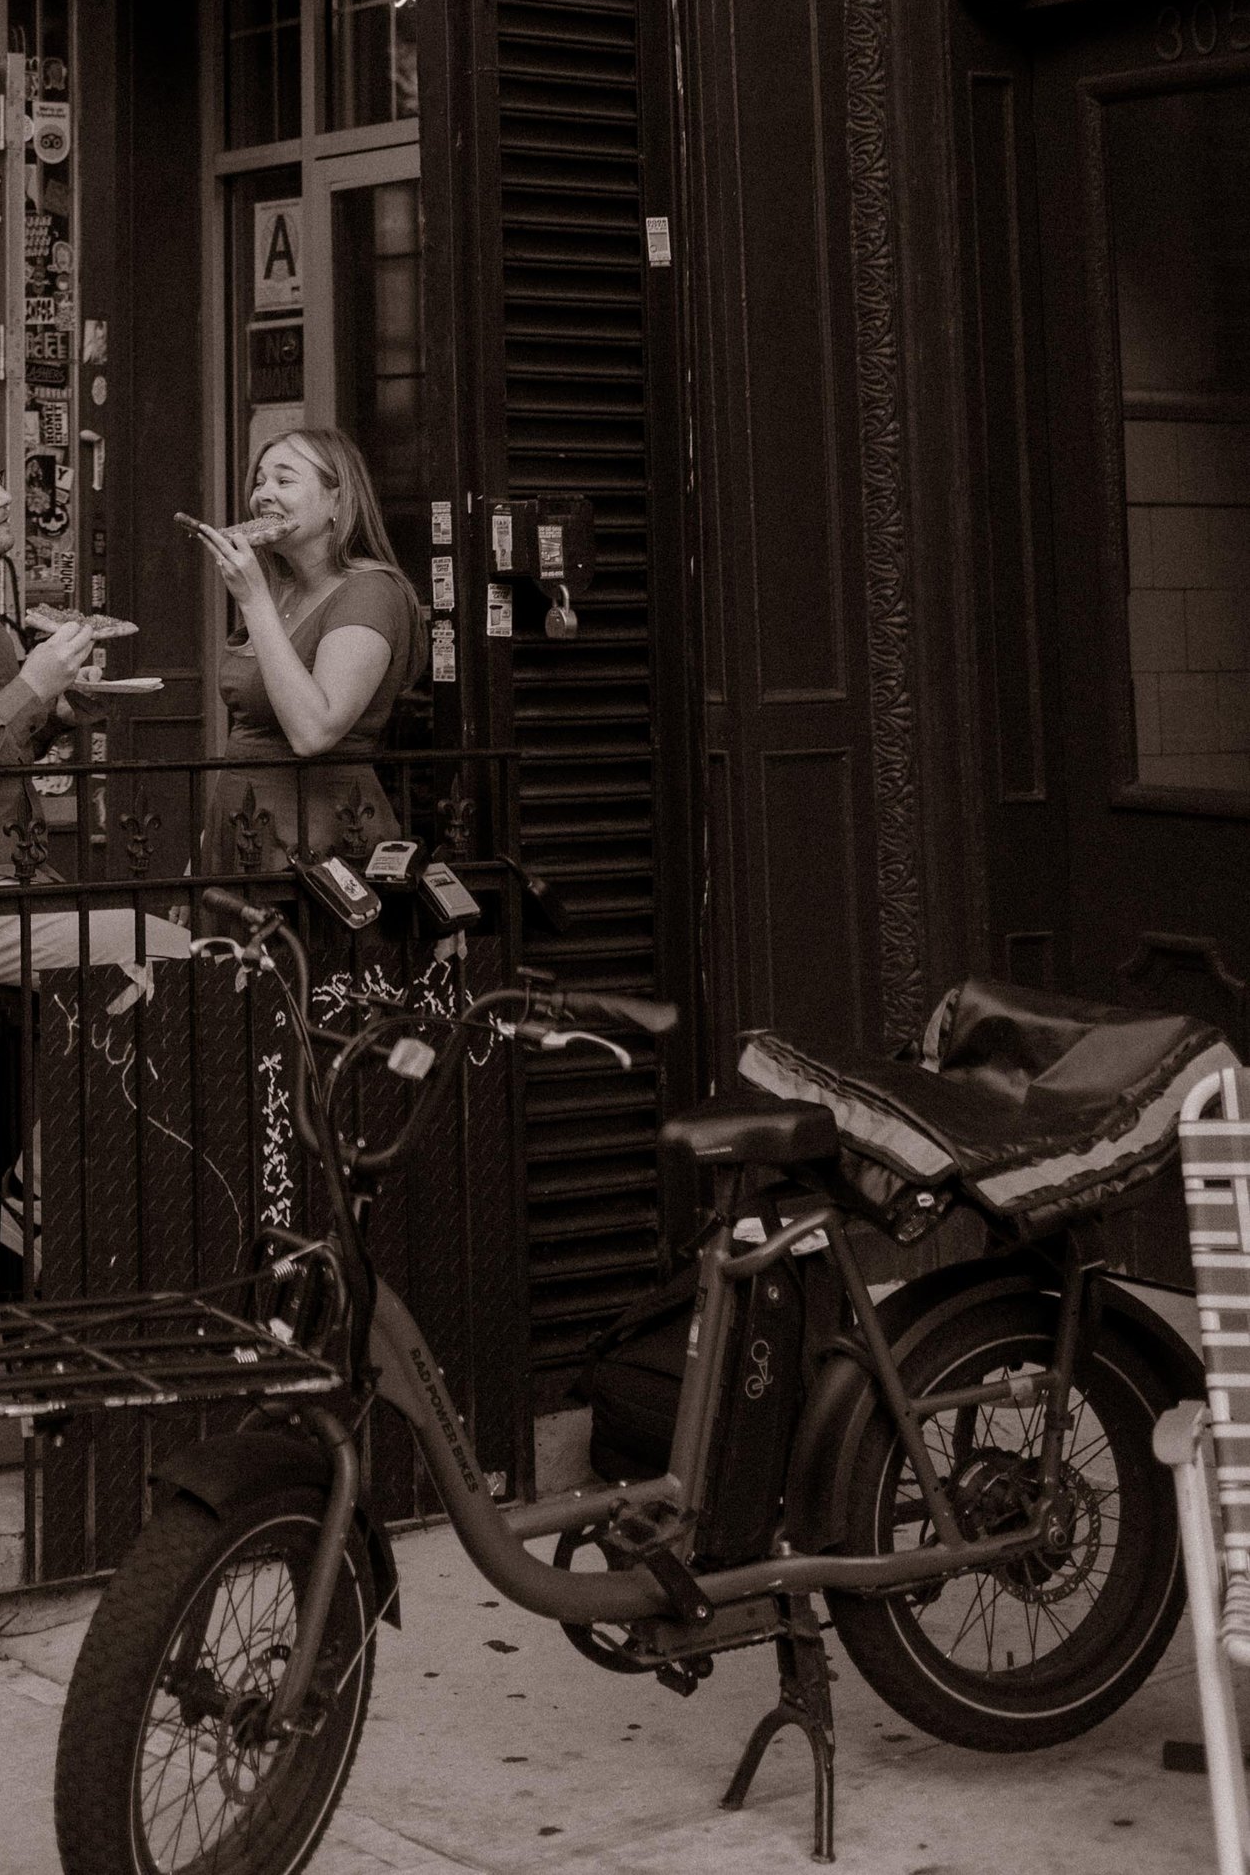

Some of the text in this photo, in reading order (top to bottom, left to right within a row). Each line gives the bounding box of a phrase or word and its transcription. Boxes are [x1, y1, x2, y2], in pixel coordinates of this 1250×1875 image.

[264, 214, 296, 280] A
[410, 1347, 480, 1494] RAD POWER BIKES
